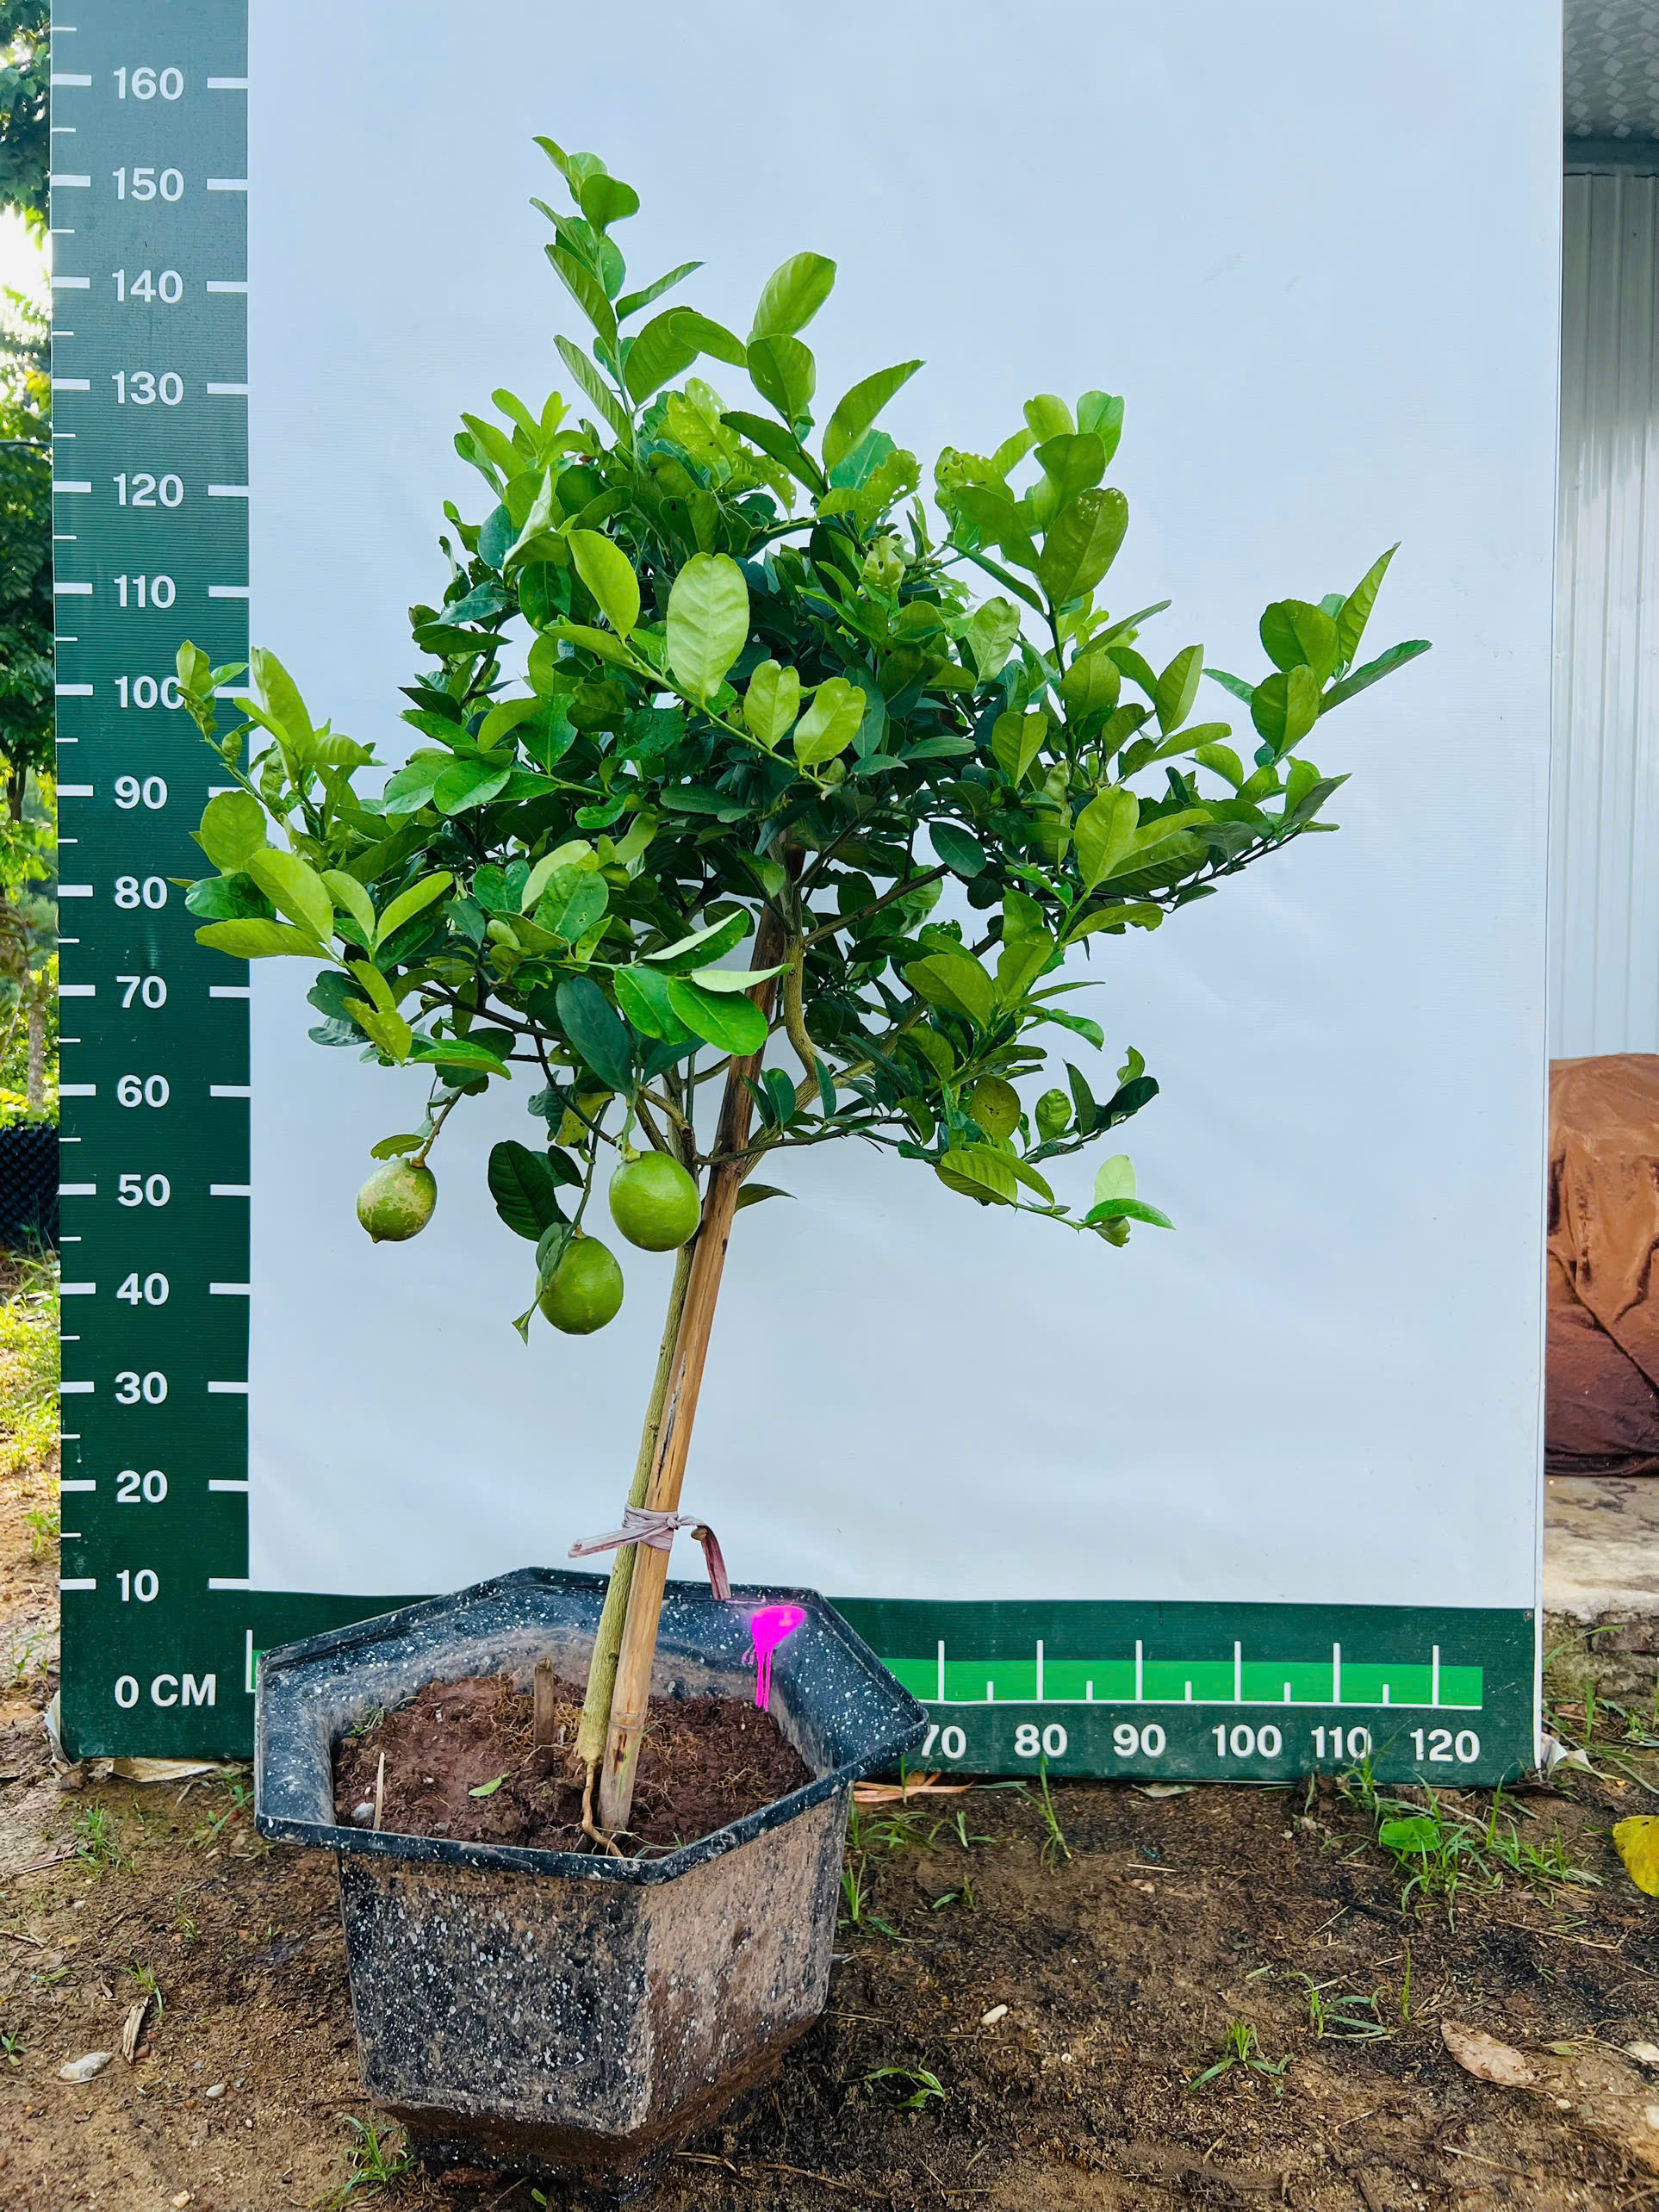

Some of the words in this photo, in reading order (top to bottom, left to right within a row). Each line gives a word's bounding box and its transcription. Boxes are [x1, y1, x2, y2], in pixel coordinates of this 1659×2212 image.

[112, 66, 184, 101] 160
[112, 167, 184, 202] 150
[111, 270, 183, 303] 140
[111, 370, 184, 406] 130
[113, 473, 184, 507] 120
[114, 575, 177, 609] 110
[115, 676, 184, 709] 100
[115, 776, 168, 810] 90
[115, 876, 168, 910] 80
[115, 975, 167, 1009] 70
[117, 1074, 170, 1108] 60
[117, 1173, 171, 1207] 50
[116, 1273, 170, 1306] 40
[115, 1371, 168, 1405] 30
[115, 1469, 168, 1503] 20
[116, 1569, 159, 1602] 10
[114, 1675, 140, 1709] 0
[151, 1674, 217, 1707] CM
[1014, 1724, 1068, 1757] 80
[1113, 1724, 1166, 1757] 90
[1212, 1724, 1283, 1758] 100
[1311, 1726, 1372, 1760] 110
[1409, 1728, 1481, 1763] 120
